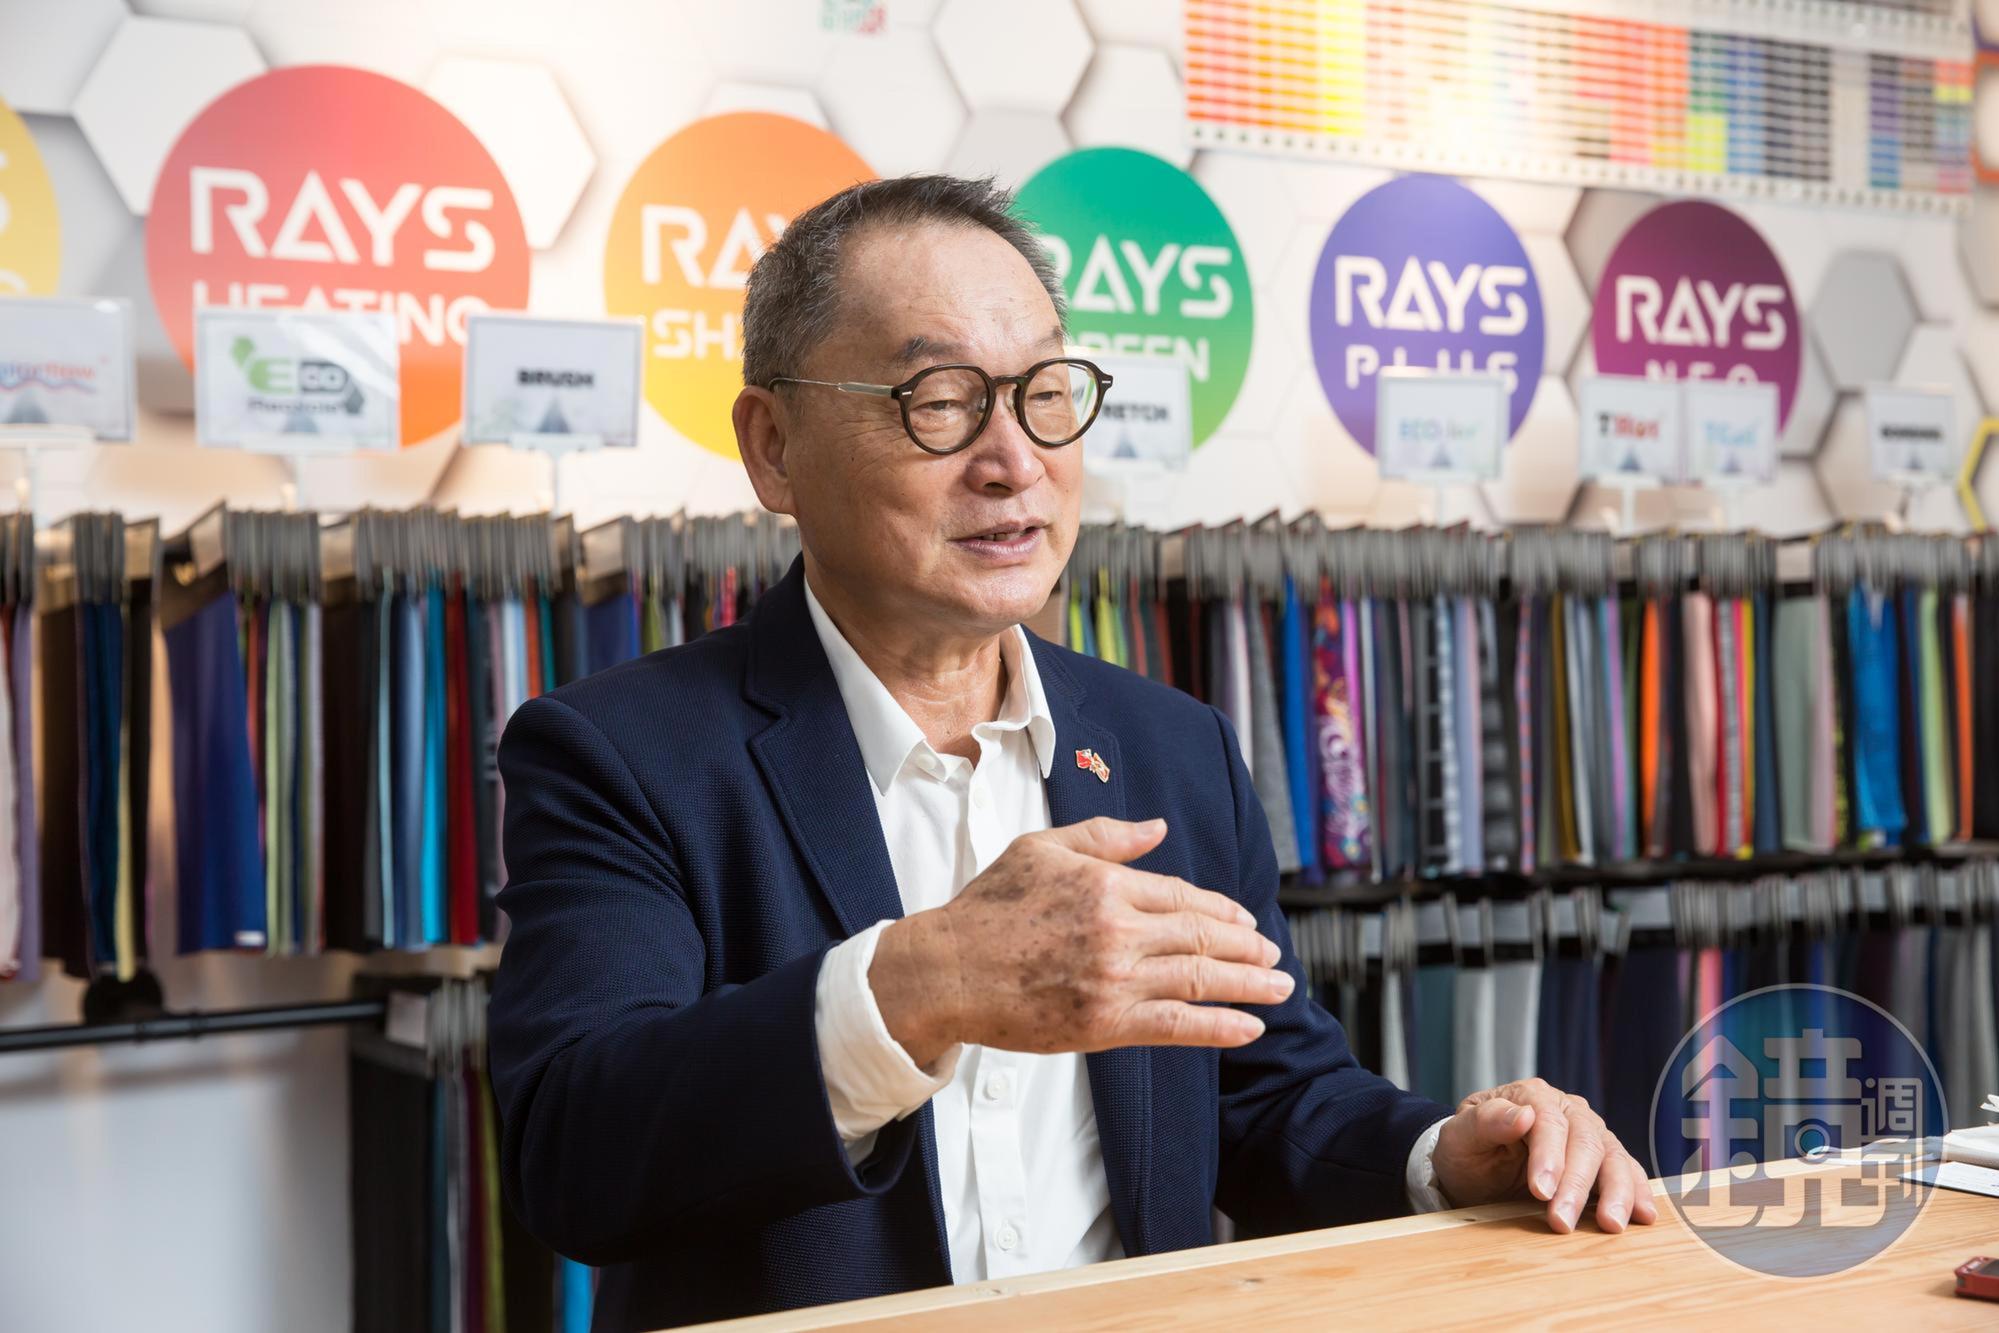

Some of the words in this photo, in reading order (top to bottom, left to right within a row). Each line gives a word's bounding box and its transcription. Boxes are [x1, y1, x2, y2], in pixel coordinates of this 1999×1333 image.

[188, 167, 496, 272] RAYS
[652, 308, 737, 359] SH
[1335, 255, 1528, 336] RAYS
[1616, 275, 1786, 350] RAYS
